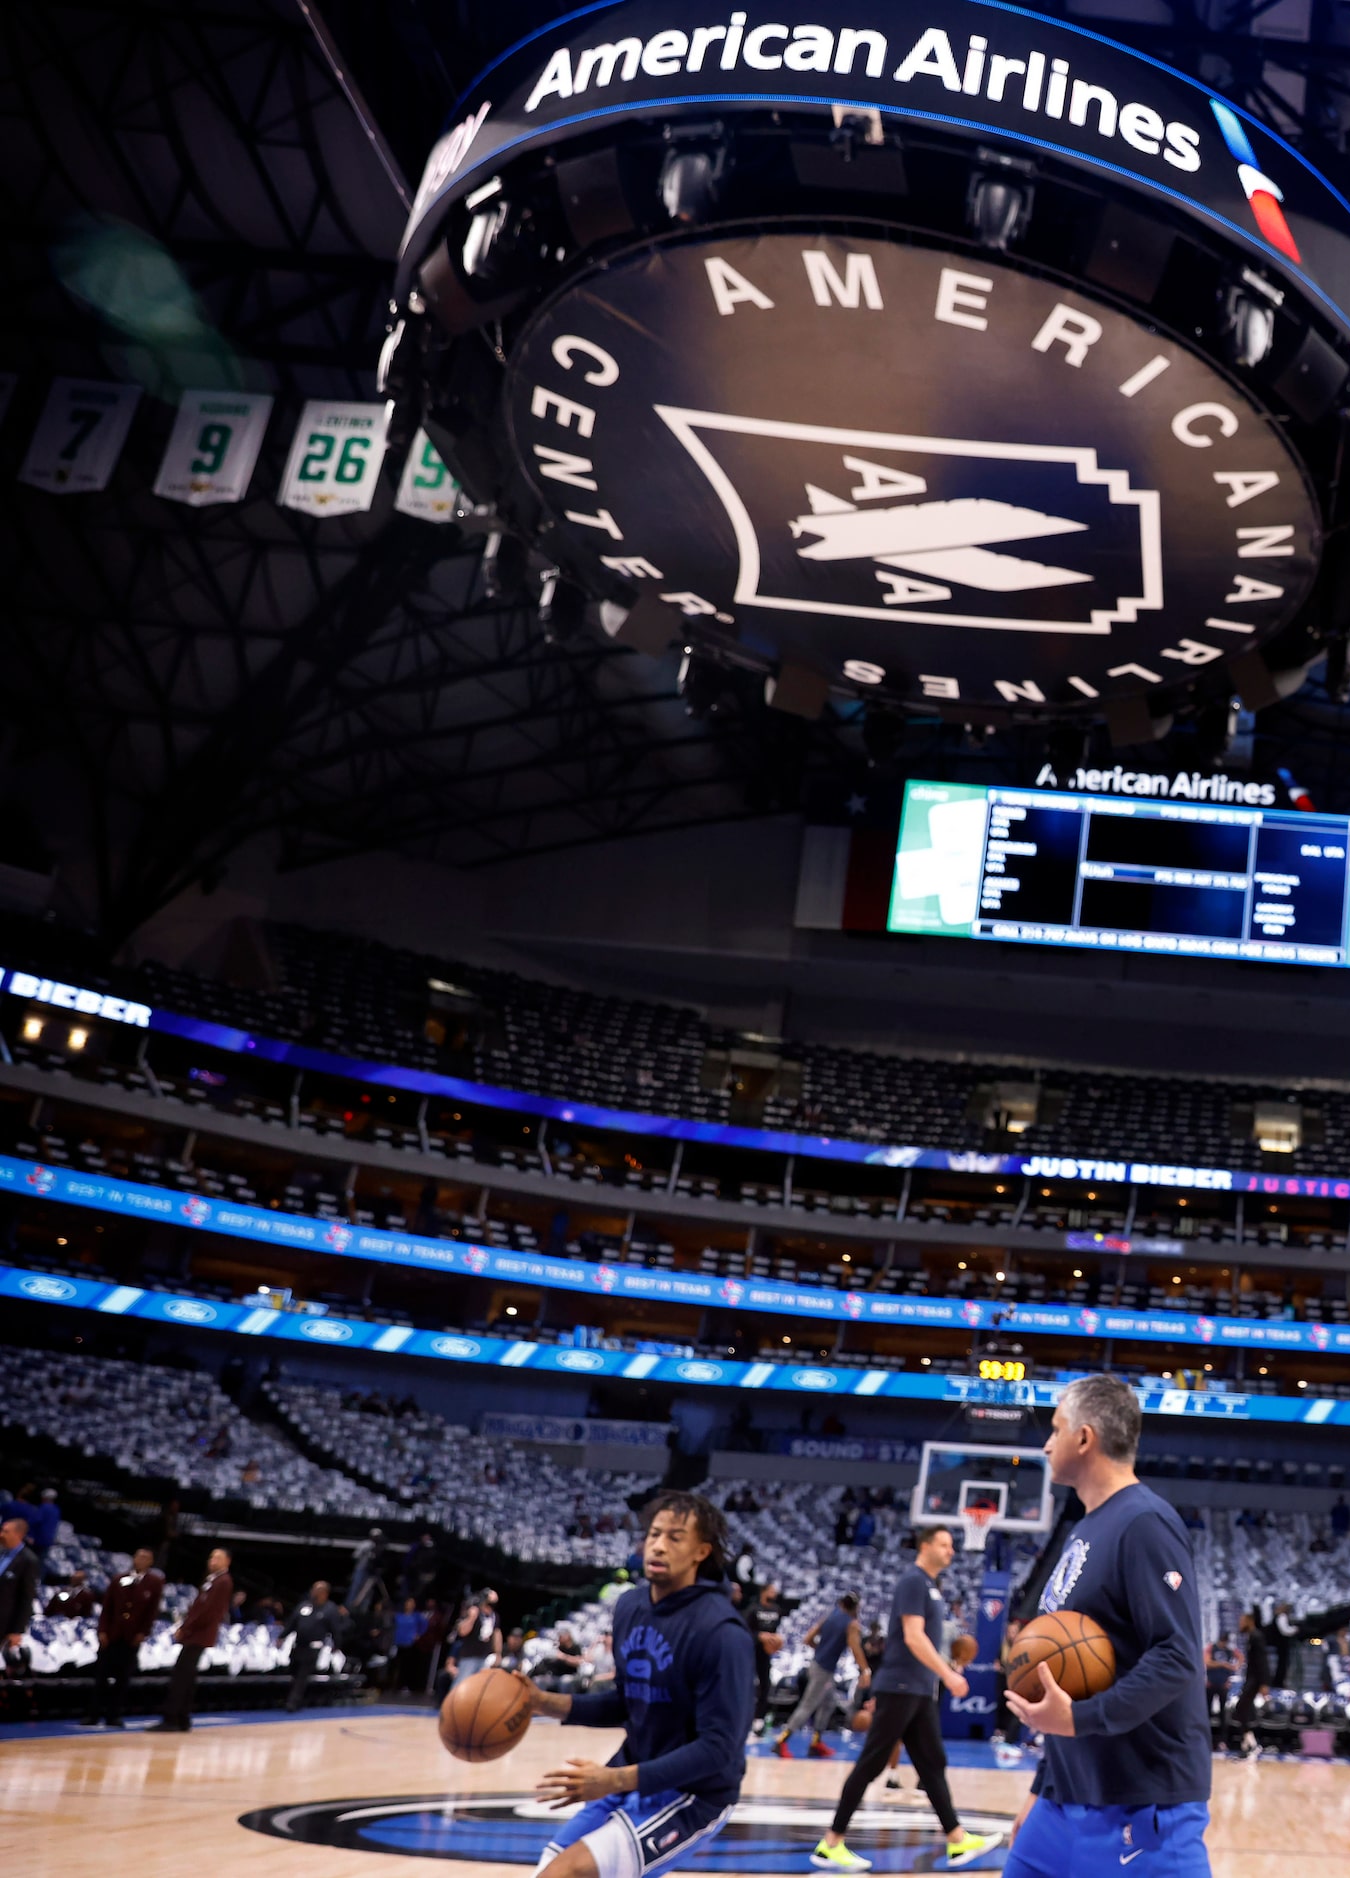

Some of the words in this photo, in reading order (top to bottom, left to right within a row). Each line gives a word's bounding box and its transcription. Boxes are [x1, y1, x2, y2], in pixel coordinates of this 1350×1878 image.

[525, 11, 888, 113] American
[893, 27, 1201, 173] Airlines
[704, 250, 1295, 558] AMERICAN
[192, 424, 231, 474] 9
[297, 433, 370, 484] 26
[531, 335, 713, 615] CENTER
[844, 575, 1284, 702] AIRLINES
[1169, 772, 1275, 805] Airlines
[9, 972, 152, 1028] BIEBER
[1021, 1156, 1126, 1182] JUSTIN
[1129, 1162, 1232, 1189] BIEBER
[216, 1210, 252, 1227] BEST
[273, 1221, 316, 1241] TEXAS
[359, 1236, 394, 1252] BEST
[412, 1244, 454, 1262] TEXAS
[495, 1258, 529, 1273] BEST
[545, 1264, 585, 1282] TEXAS
[624, 1276, 657, 1290] BEST
[658, 1279, 671, 1292] IN
[672, 1280, 711, 1296] TEXAS
[749, 1290, 781, 1304] BEST
[783, 1293, 796, 1306] IN
[797, 1295, 834, 1310] TEXAS
[871, 1302, 900, 1316] BEST
[916, 1306, 952, 1319] TEXAS
[1033, 1313, 1070, 1327] TEXAS
[1106, 1317, 1136, 1331] BEST
[1151, 1321, 1186, 1334] TEXAS
[1222, 1326, 1253, 1339] BEST
[1267, 1329, 1302, 1342] TEXAS
[790, 1439, 863, 1458] SOUND
[877, 1444, 920, 1462] STA
